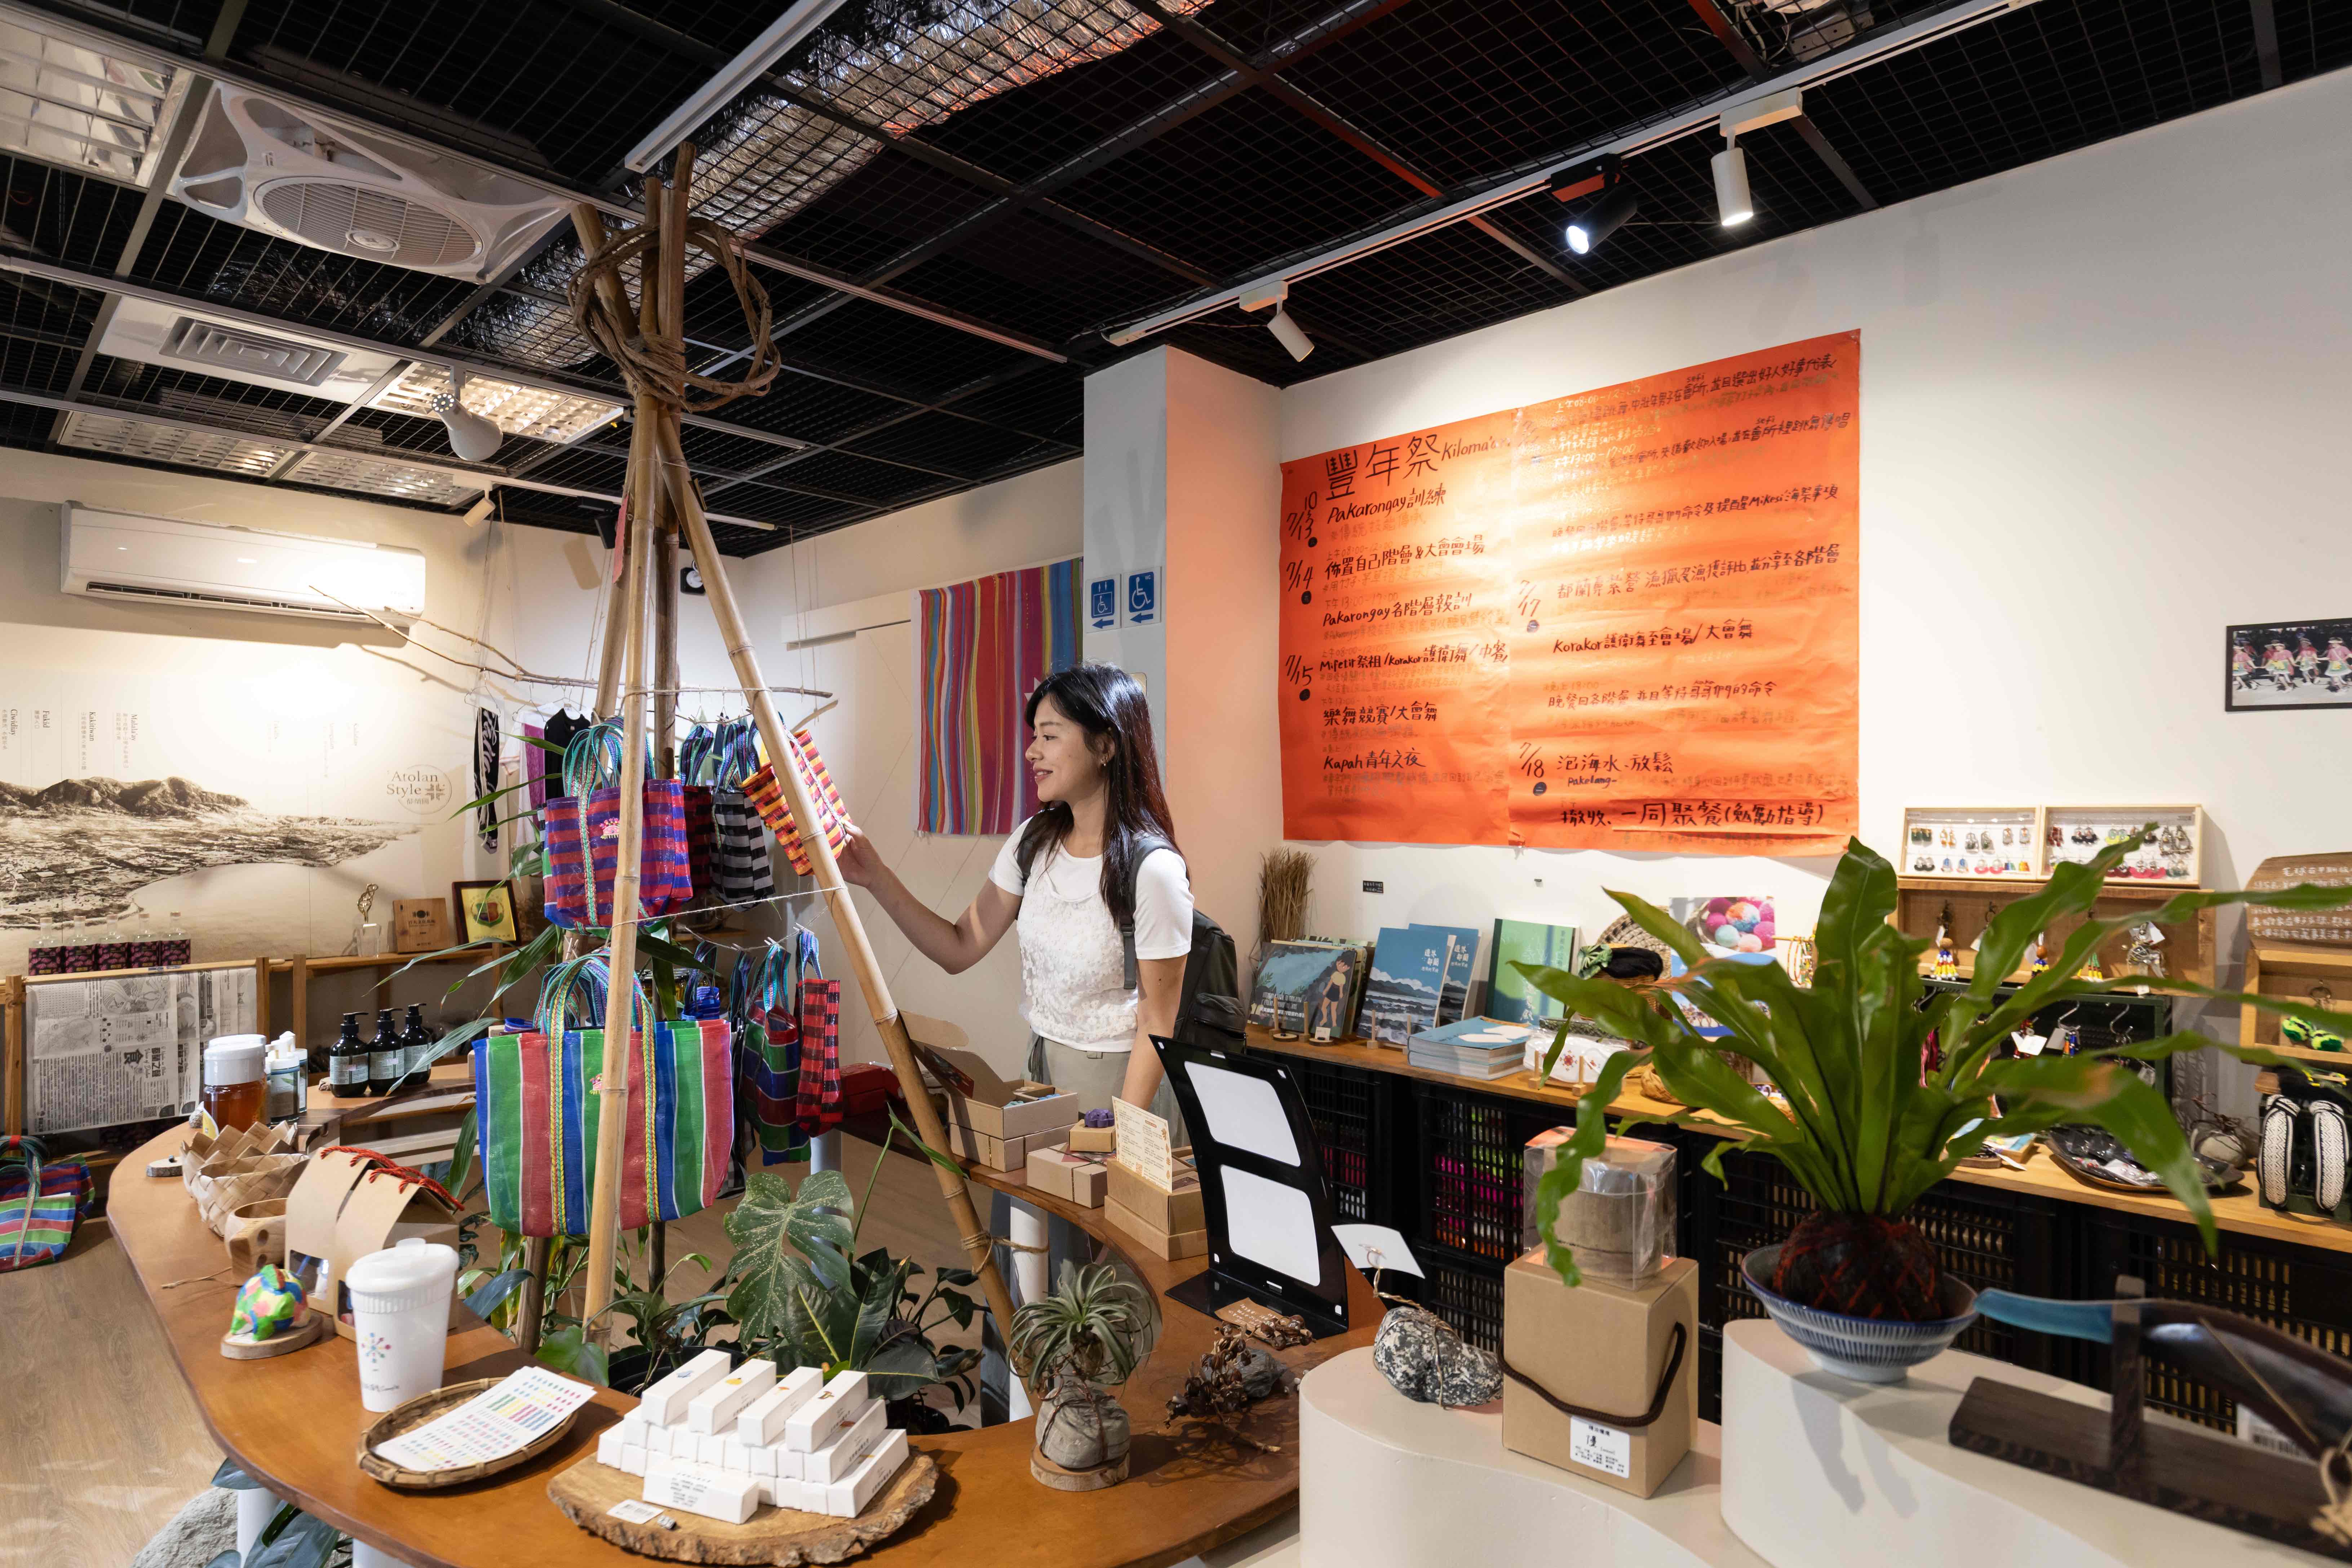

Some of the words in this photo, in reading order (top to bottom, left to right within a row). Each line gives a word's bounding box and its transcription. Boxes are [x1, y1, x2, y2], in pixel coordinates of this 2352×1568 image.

[1325, 434, 1440, 500] 豐年祭
[1286, 559, 1314, 592] 7/14
[1518, 580, 1541, 617] 7/17
[1285, 654, 1314, 686] 7/15
[1366, 747, 1427, 769] 青年之夜
[1519, 742, 1545, 778] 7/18
[387, 783, 421, 798] Style
[124, 1049, 144, 1064] 食
